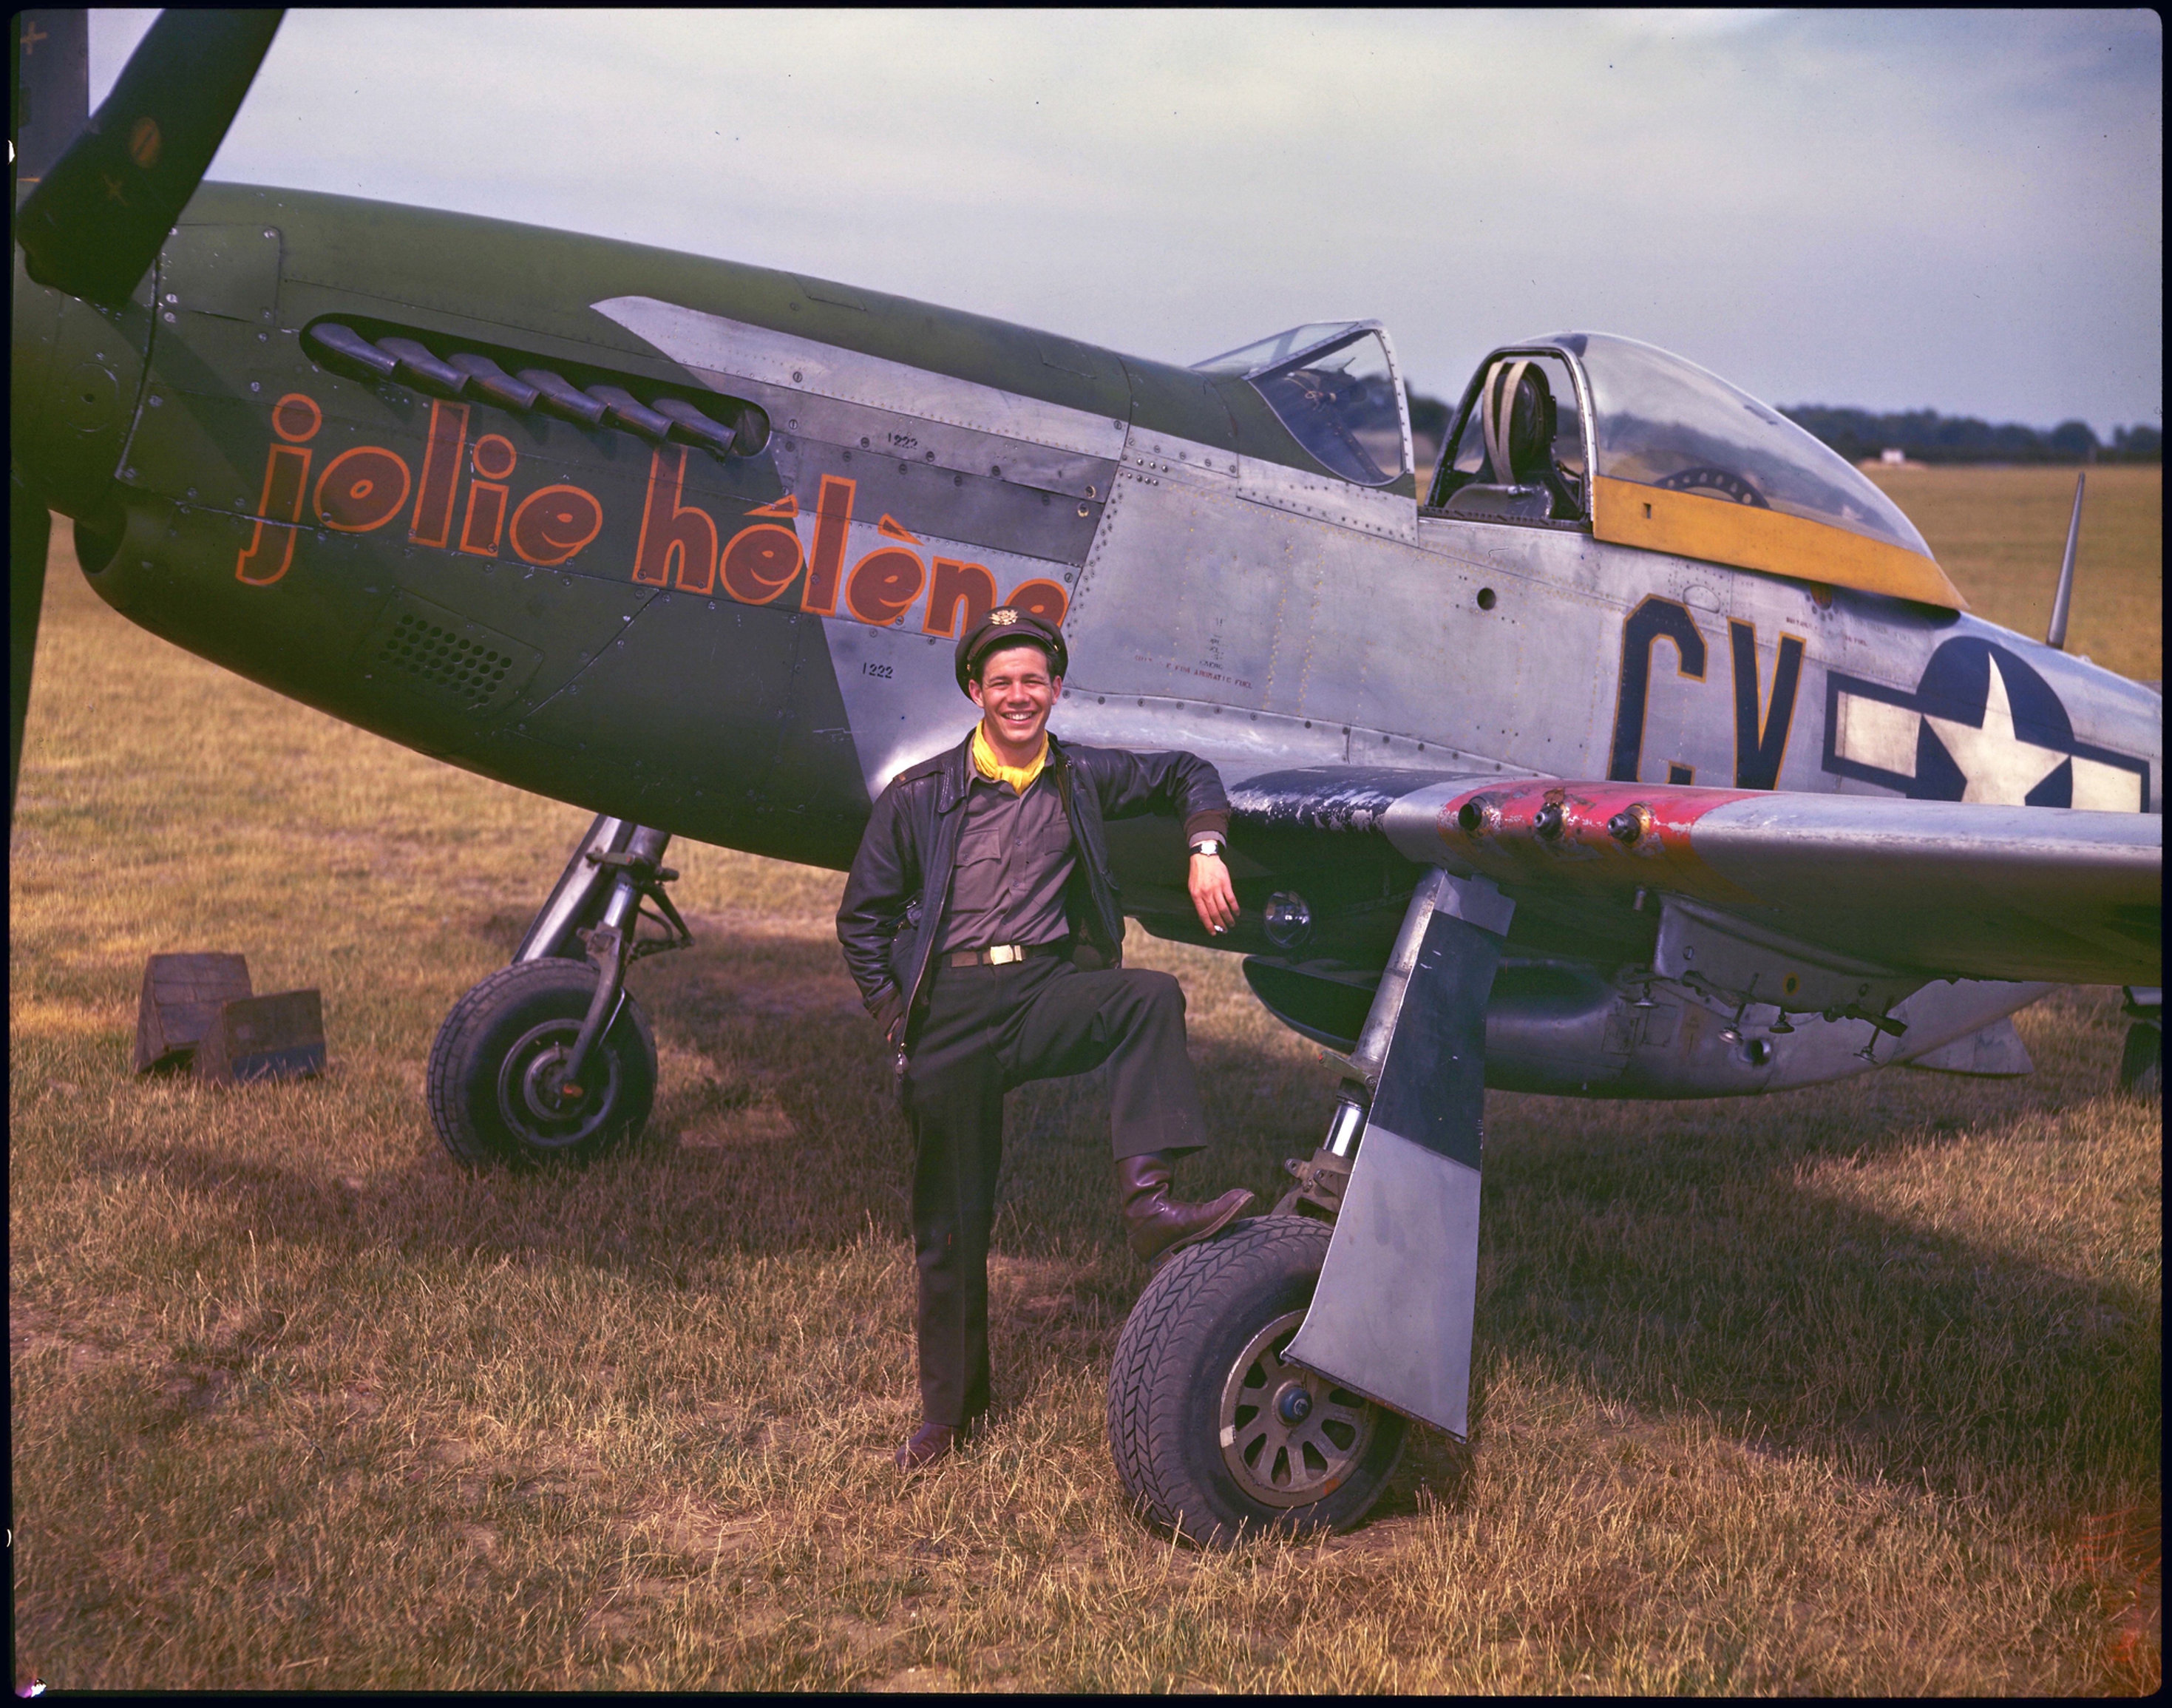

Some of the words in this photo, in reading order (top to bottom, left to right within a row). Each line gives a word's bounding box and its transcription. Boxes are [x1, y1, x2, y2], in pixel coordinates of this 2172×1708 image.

[235, 393, 603, 586] jolie
[888, 433, 917, 450] 1222
[863, 662, 893, 679] 1222
[1606, 593, 1806, 790] CV
